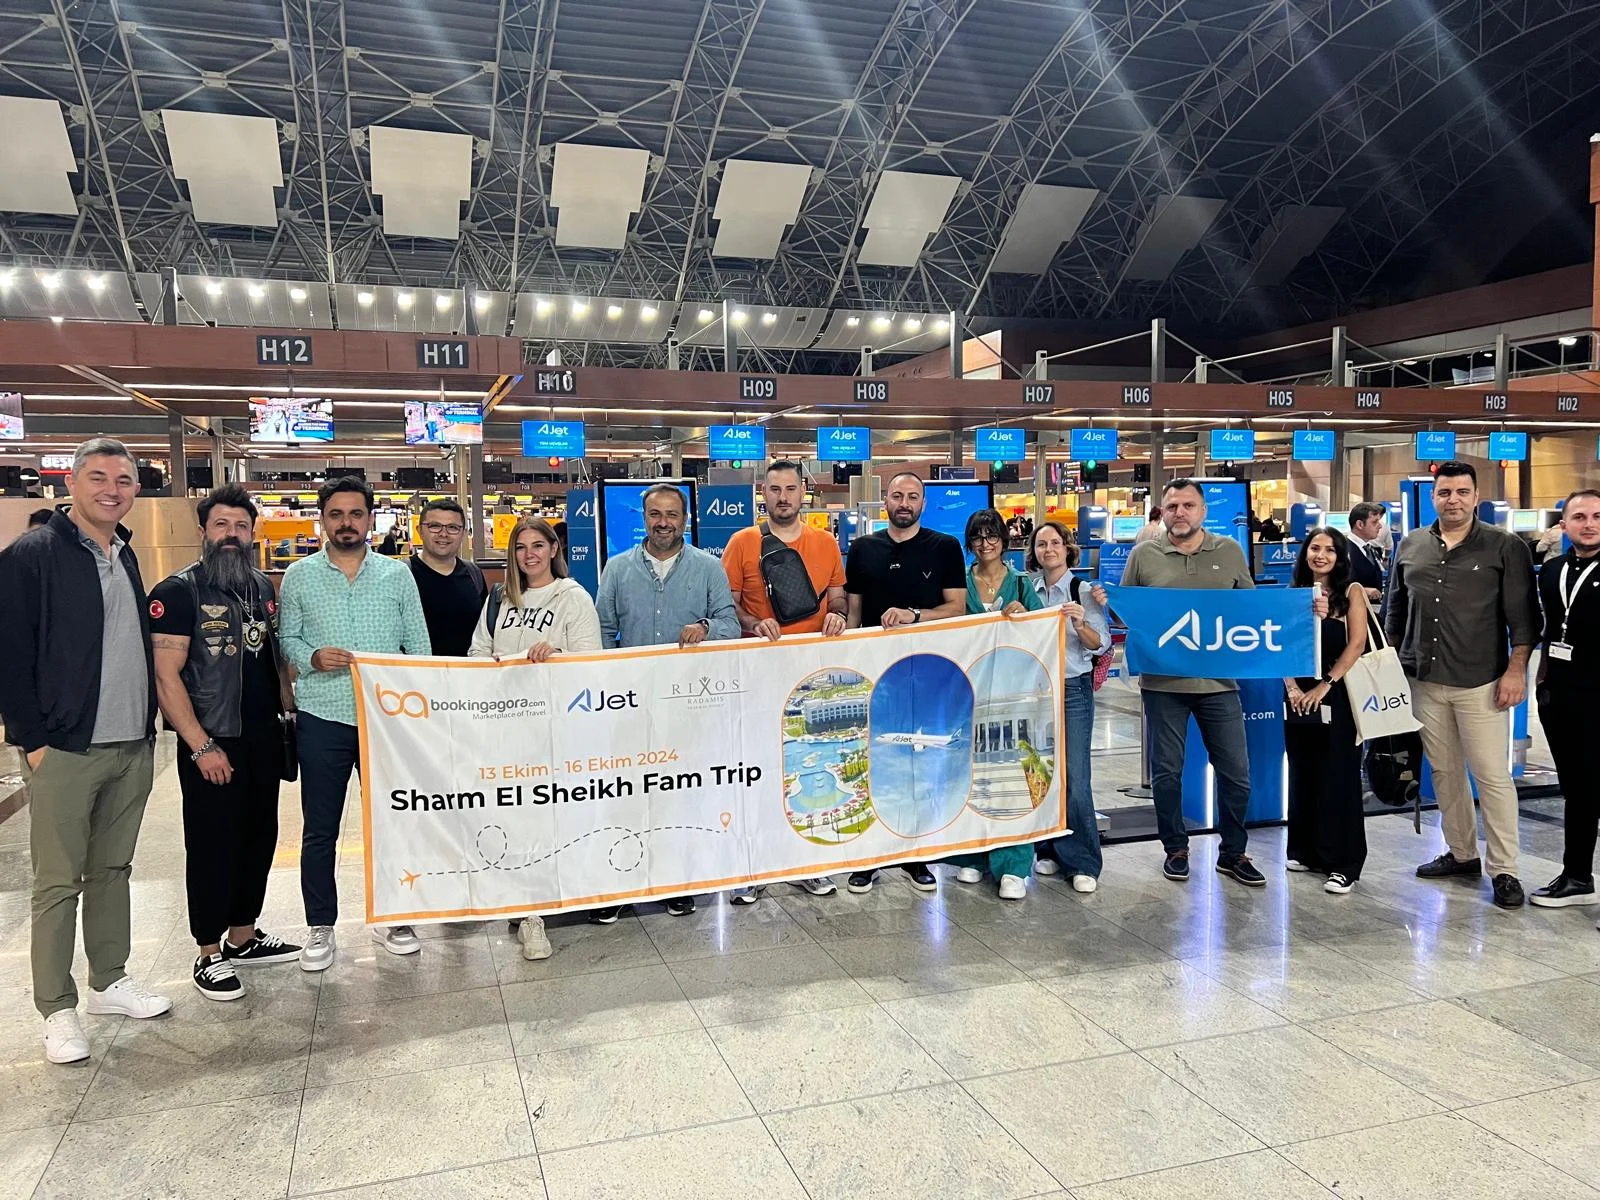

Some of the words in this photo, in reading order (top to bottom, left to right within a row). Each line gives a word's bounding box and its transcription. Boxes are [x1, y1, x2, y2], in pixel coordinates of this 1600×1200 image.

[261, 339, 308, 362] H12
[423, 343, 464, 365] H11
[538, 371, 573, 392] H10
[743, 380, 774, 398] H09
[857, 383, 886, 400] H08
[1025, 386, 1052, 402] H07
[1124, 388, 1150, 403] H06
[1269, 391, 1293, 406] H05
[1357, 393, 1380, 407] H04
[1485, 396, 1507, 410] H03
[1558, 397, 1578, 411] H02
[538, 423, 569, 436] AJet
[723, 427, 752, 439] AJet
[830, 429, 857, 440] AJet
[988, 430, 1012, 441] AJet
[1082, 431, 1106, 441] AJet
[1222, 432, 1244, 441] AJet
[1304, 432, 1325, 442] AJet
[706, 498, 745, 516] AJet
[1158, 608, 1282, 652] AJet
[672, 677, 740, 696] RIXOS
[430, 698, 546, 713] bookingagora.com
[567, 687, 639, 713] AJet
[687, 696, 725, 705] RADAMIS
[1362, 692, 1409, 713] AJet
[472, 712, 515, 720] Marketplace
[478, 766, 497, 780] 13
[502, 763, 548, 779] Ekim
[564, 760, 583, 774] 16
[588, 754, 632, 772] Ekim
[637, 748, 679, 766] 2024
[390, 788, 485, 812] Sharm
[496, 785, 523, 807] El
[532, 776, 633, 805] Sheikh
[643, 771, 701, 794] Fam
[710, 761, 762, 787] Trip
